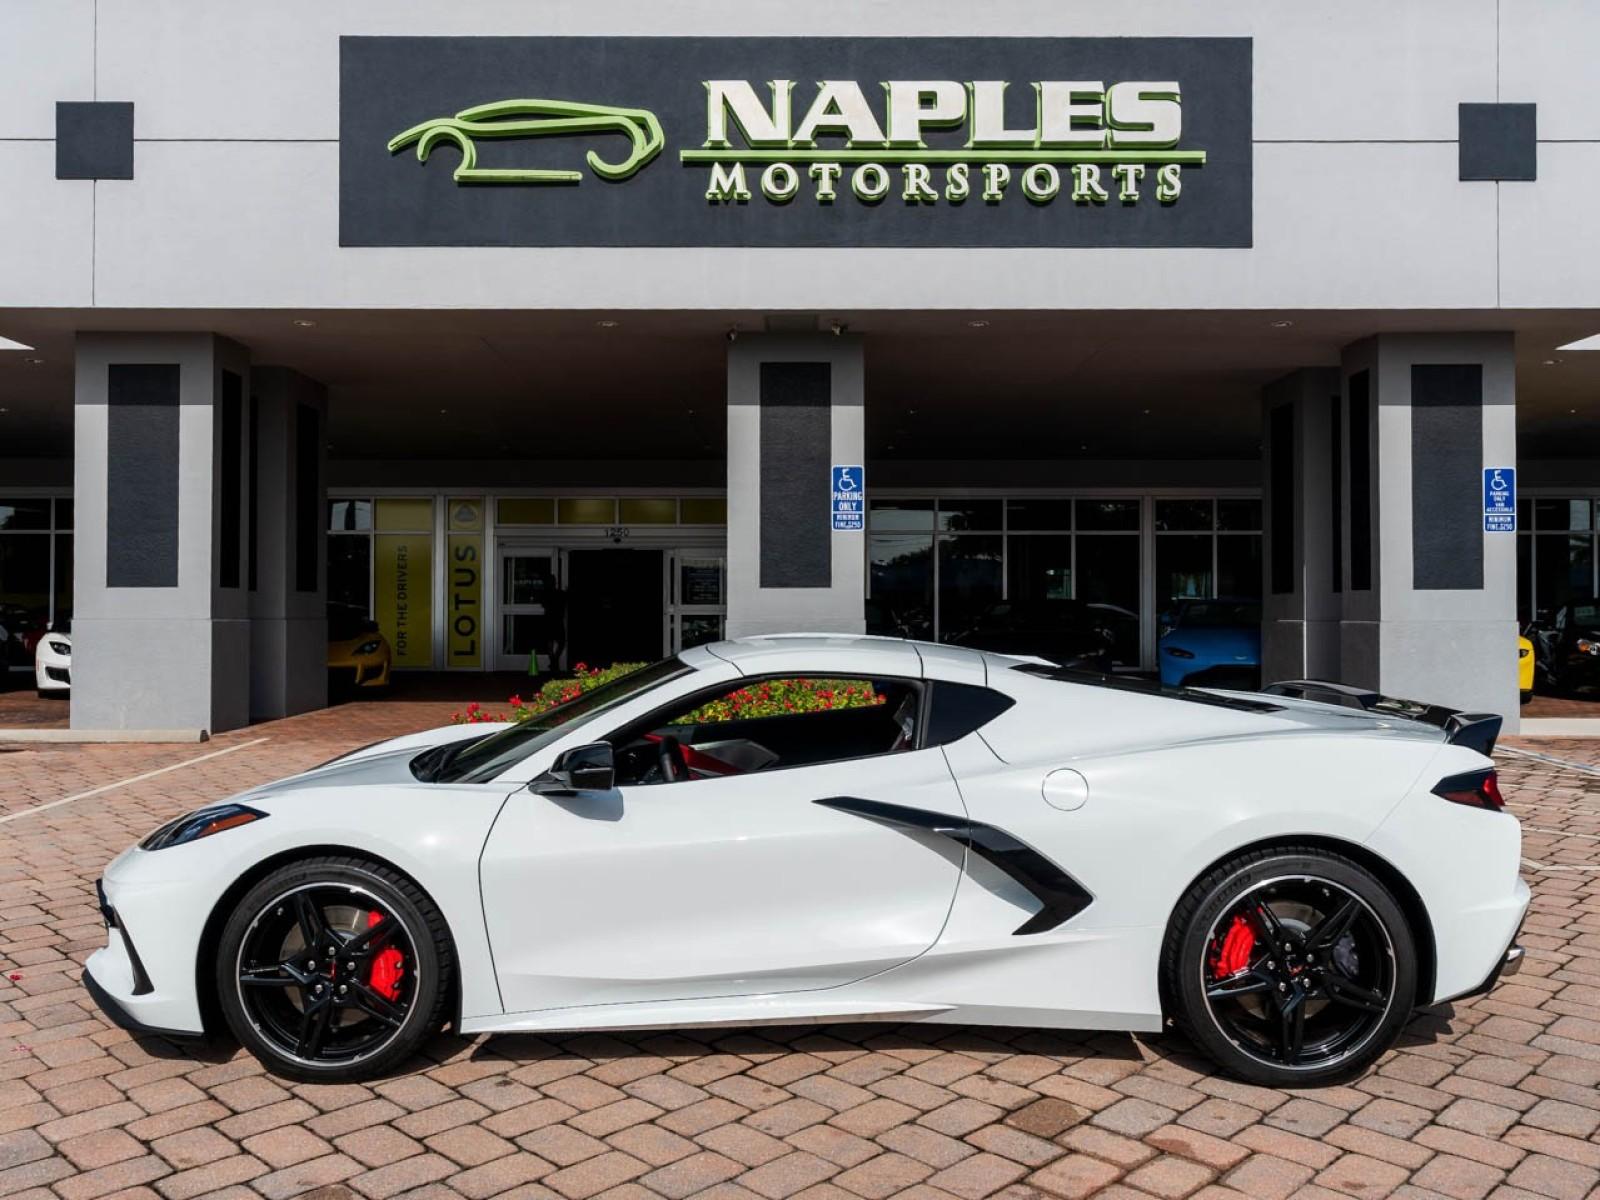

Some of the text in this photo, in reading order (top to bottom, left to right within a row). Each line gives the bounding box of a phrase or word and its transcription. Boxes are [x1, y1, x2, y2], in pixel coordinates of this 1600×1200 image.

[703, 79, 1183, 149] NAPLES
[705, 163, 1182, 201] MOTORSPORTS
[832, 491, 862, 500] PARKING
[839, 502, 856, 511] ONLY
[605, 527, 630, 537] 1250
[397, 545, 408, 656] FOR THE DRIVERS
[454, 544, 476, 656] LOTUS
